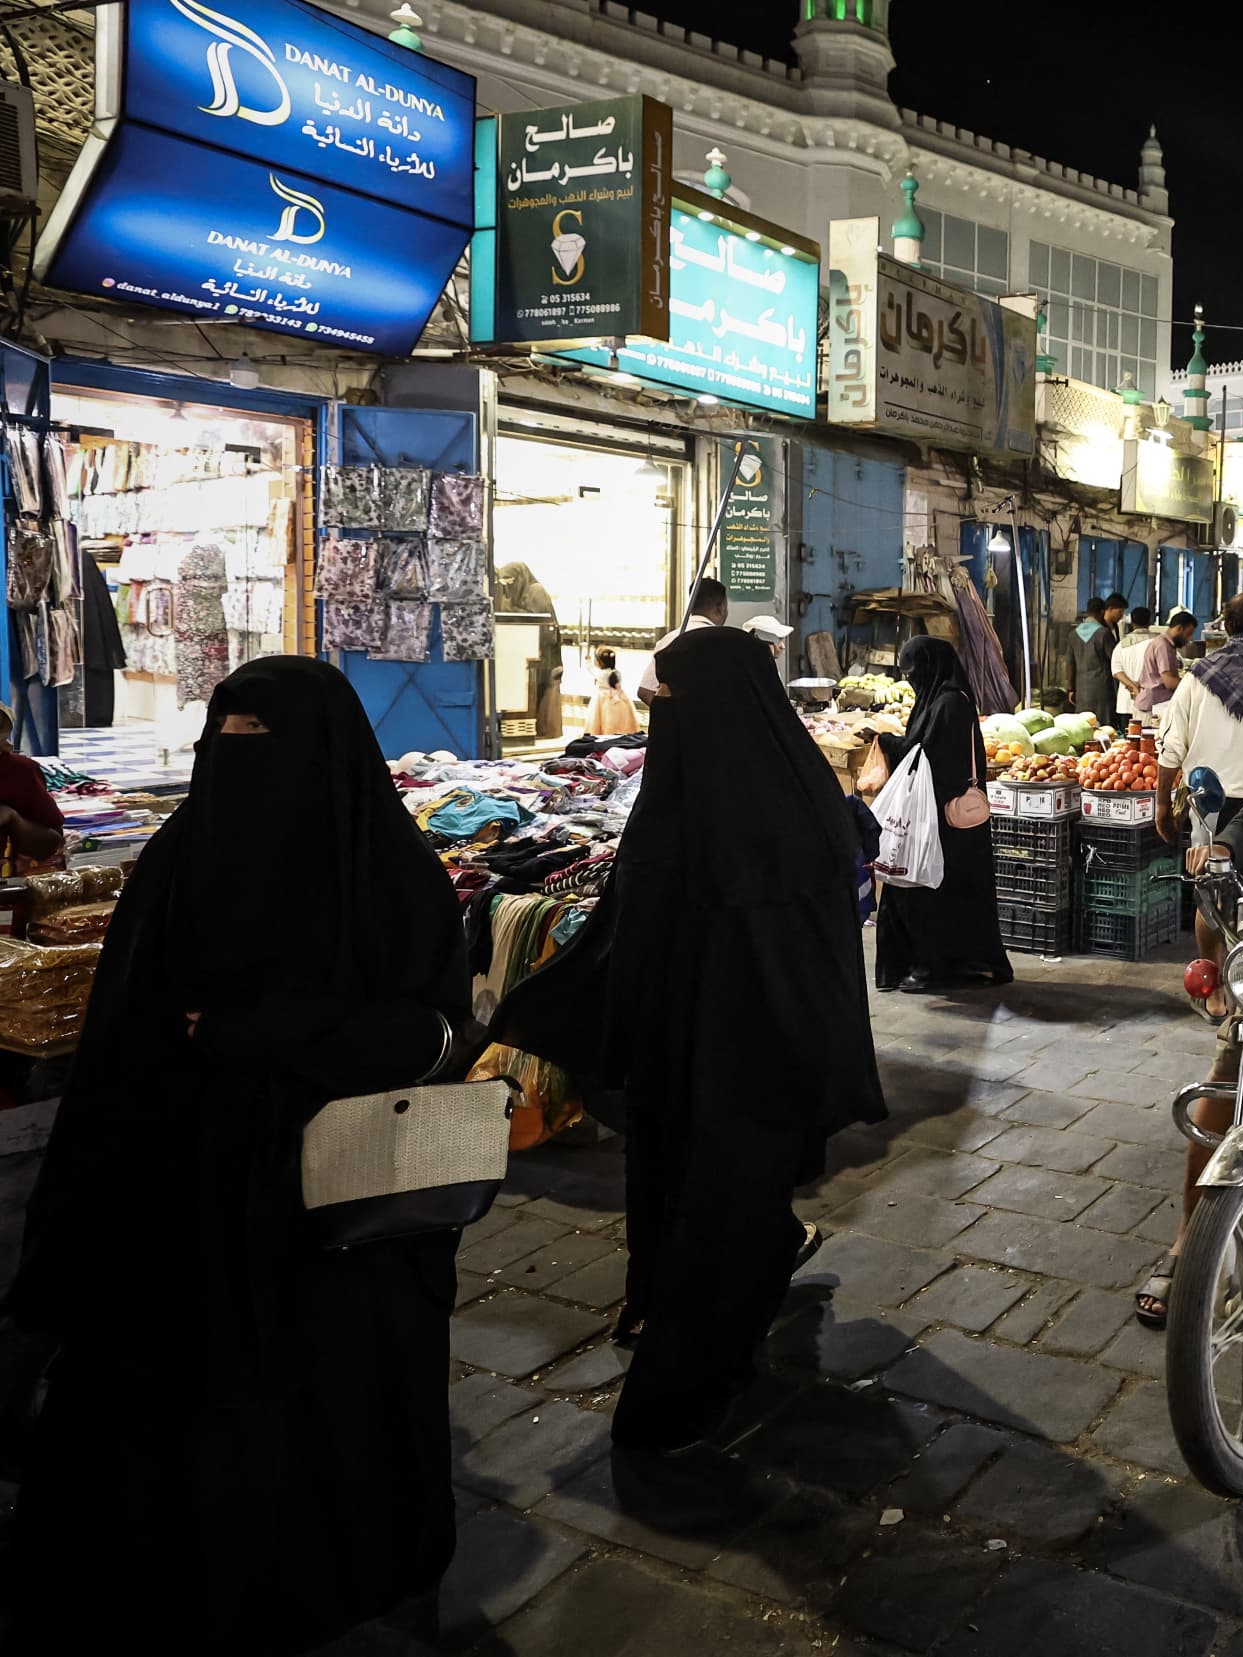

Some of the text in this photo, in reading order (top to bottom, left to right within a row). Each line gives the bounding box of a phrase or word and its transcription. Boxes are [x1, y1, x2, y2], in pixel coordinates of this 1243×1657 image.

[285, 43, 445, 122] DANAT AL-DUNYA
[314, 82, 422, 142] دانة الدنيا
[524, 112, 616, 152] صالح
[301, 119, 375, 158] النسائية
[507, 146, 634, 192] باكرمان
[508, 184, 634, 210] لبيع وشراء الذهب والمجوهرات
[207, 230, 351, 279] DANAT AL-DUNYA
[233, 258, 312, 289] دانة الدنيا
[669, 225, 786, 294] صالح
[201, 278, 268, 302] النسائية
[669, 297, 806, 363] باكرم
[835, 284, 872, 408] باكرمان
[879, 289, 988, 377] باكرمان
[725, 505, 770, 521] باكرمان
